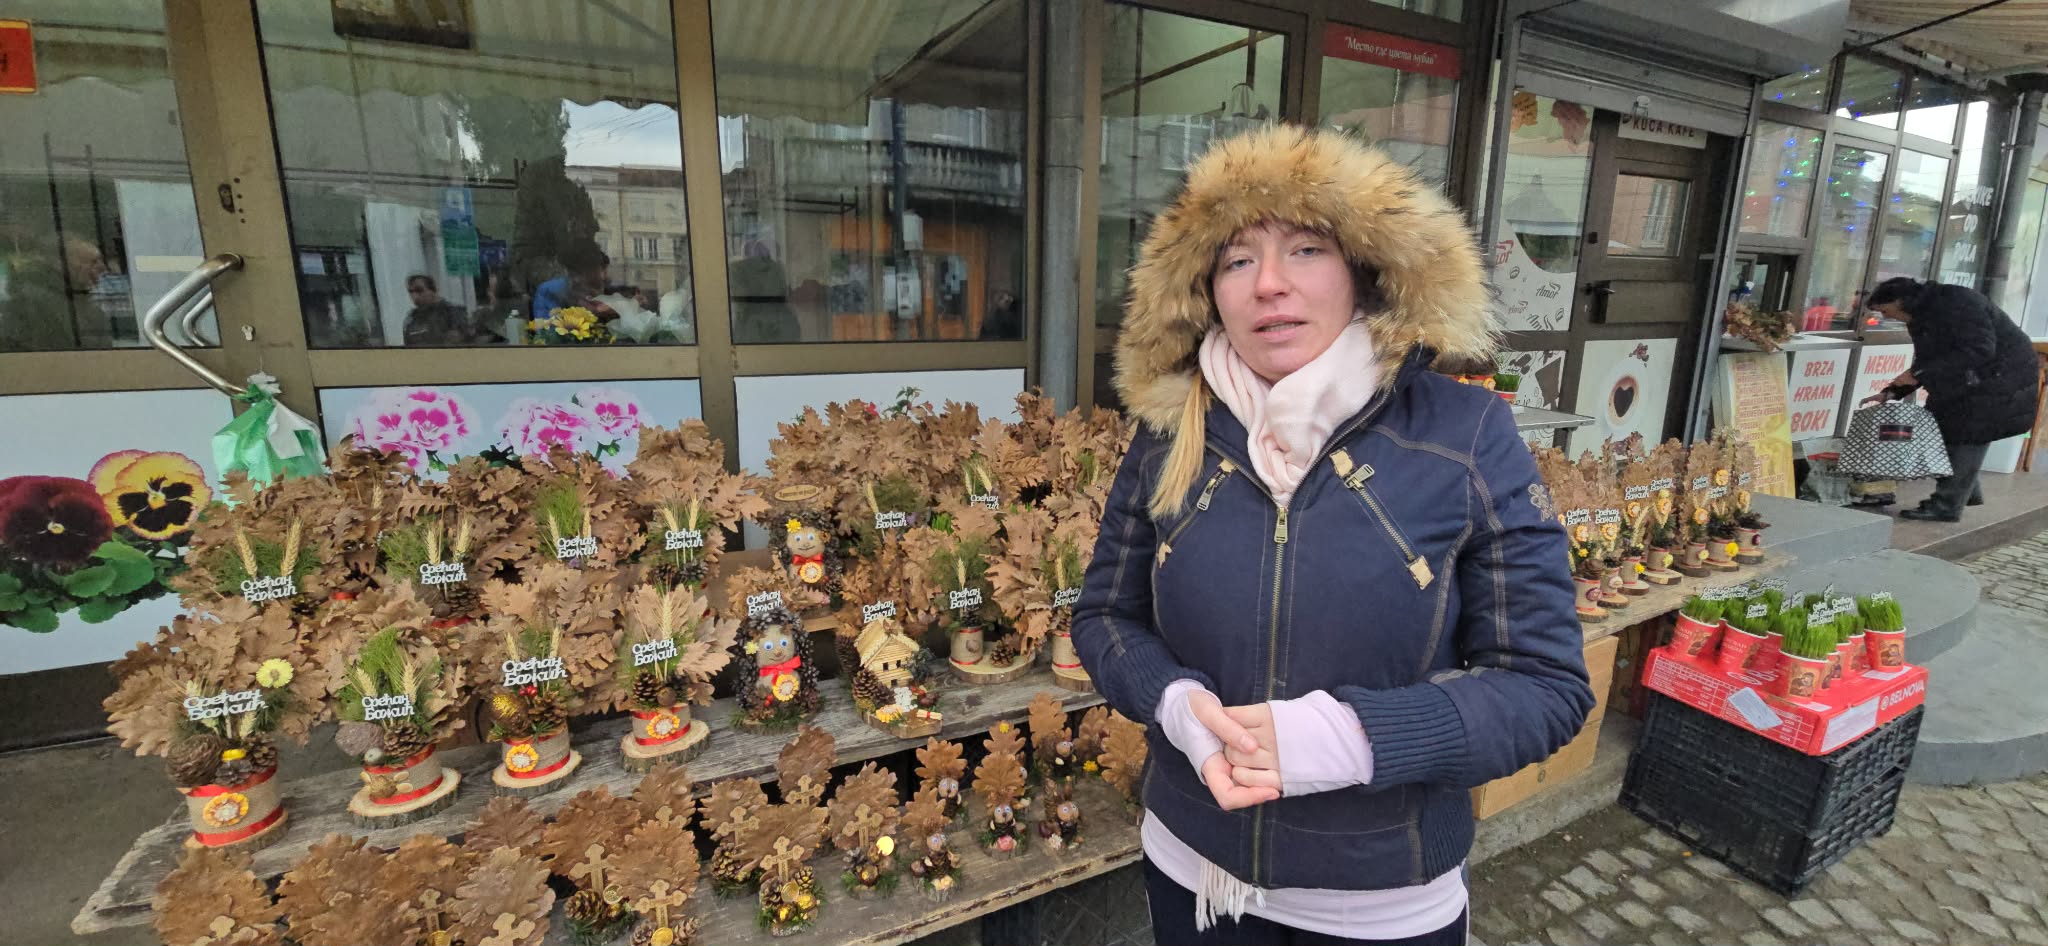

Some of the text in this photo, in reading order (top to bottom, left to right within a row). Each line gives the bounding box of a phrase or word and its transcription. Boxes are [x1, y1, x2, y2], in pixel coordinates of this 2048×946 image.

[1804, 360, 1835, 377] BRZA
[1793, 384, 1835, 402] HRANA
[1791, 409, 1831, 433] BOKI
